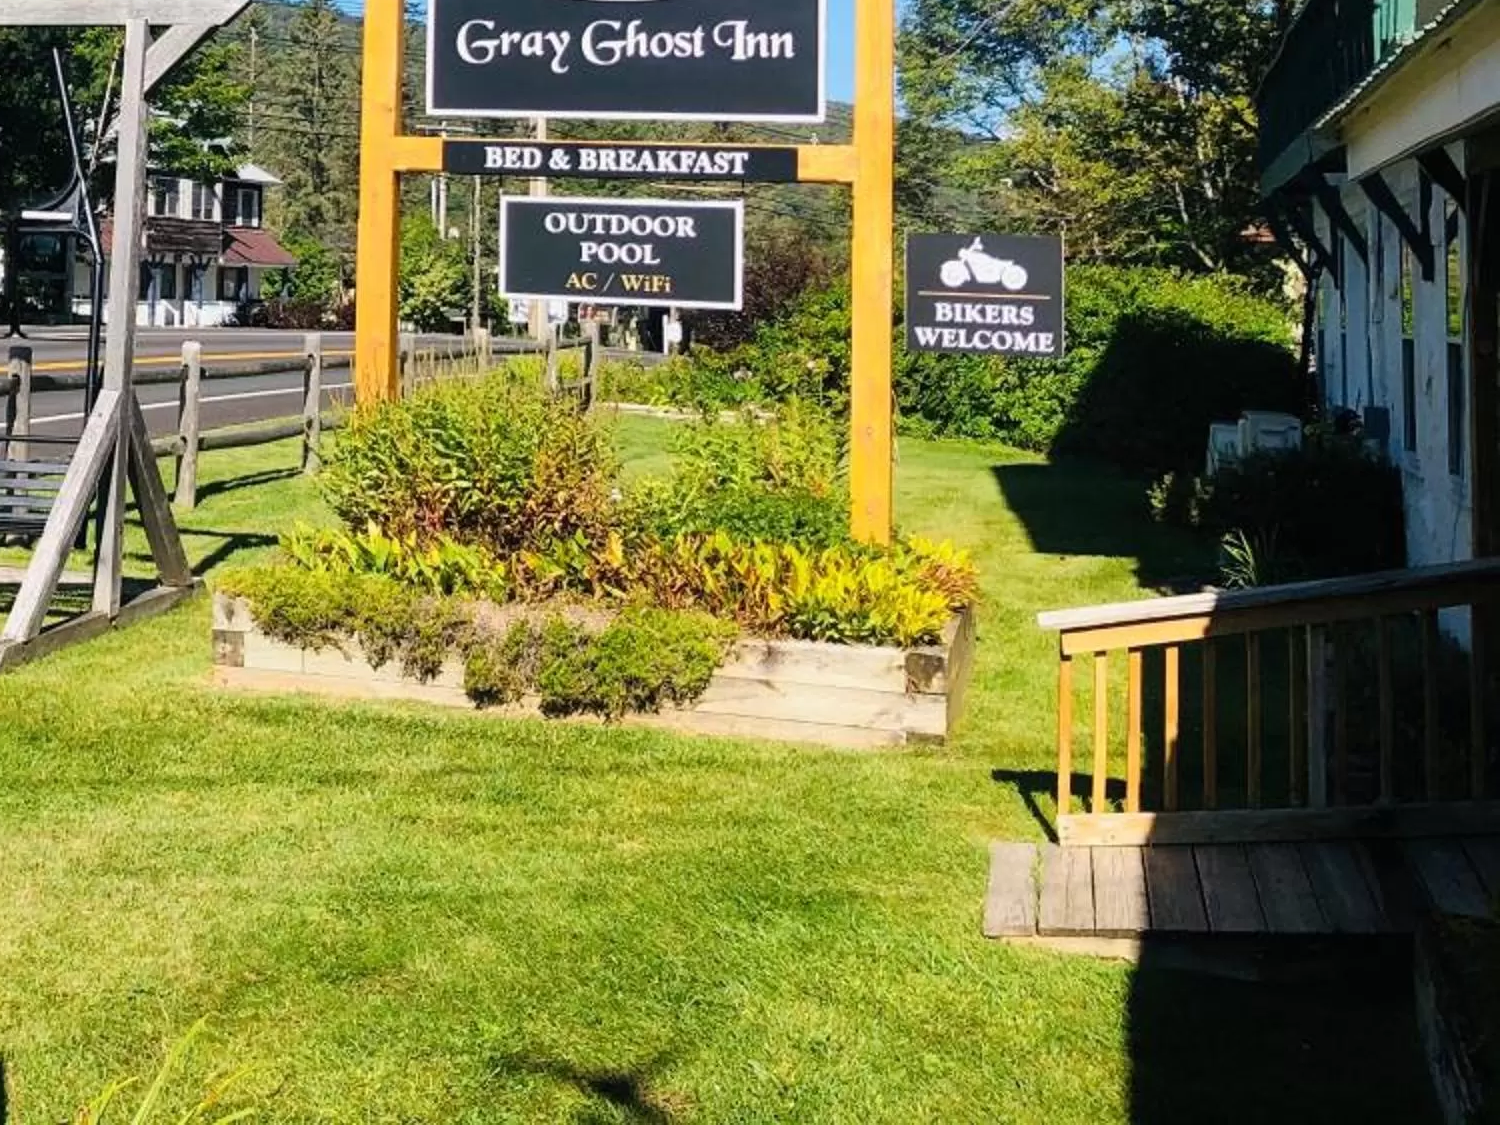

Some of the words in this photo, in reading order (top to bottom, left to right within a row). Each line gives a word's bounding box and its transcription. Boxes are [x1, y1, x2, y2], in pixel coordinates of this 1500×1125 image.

[455, 19, 571, 74] Gray
[580, 18, 705, 66] Ghost
[712, 19, 796, 61] Inn
[484, 146, 543, 170] BED
[549, 148, 571, 171] &
[578, 148, 749, 175] BREAKFAST
[544, 212, 697, 238] OUTDOOR
[579, 242, 661, 265] POOL
[564, 272, 598, 291] AC
[621, 274, 673, 294] WiFi
[934, 302, 1035, 325] BIKERS
[913, 326, 1056, 353] WELCOME
